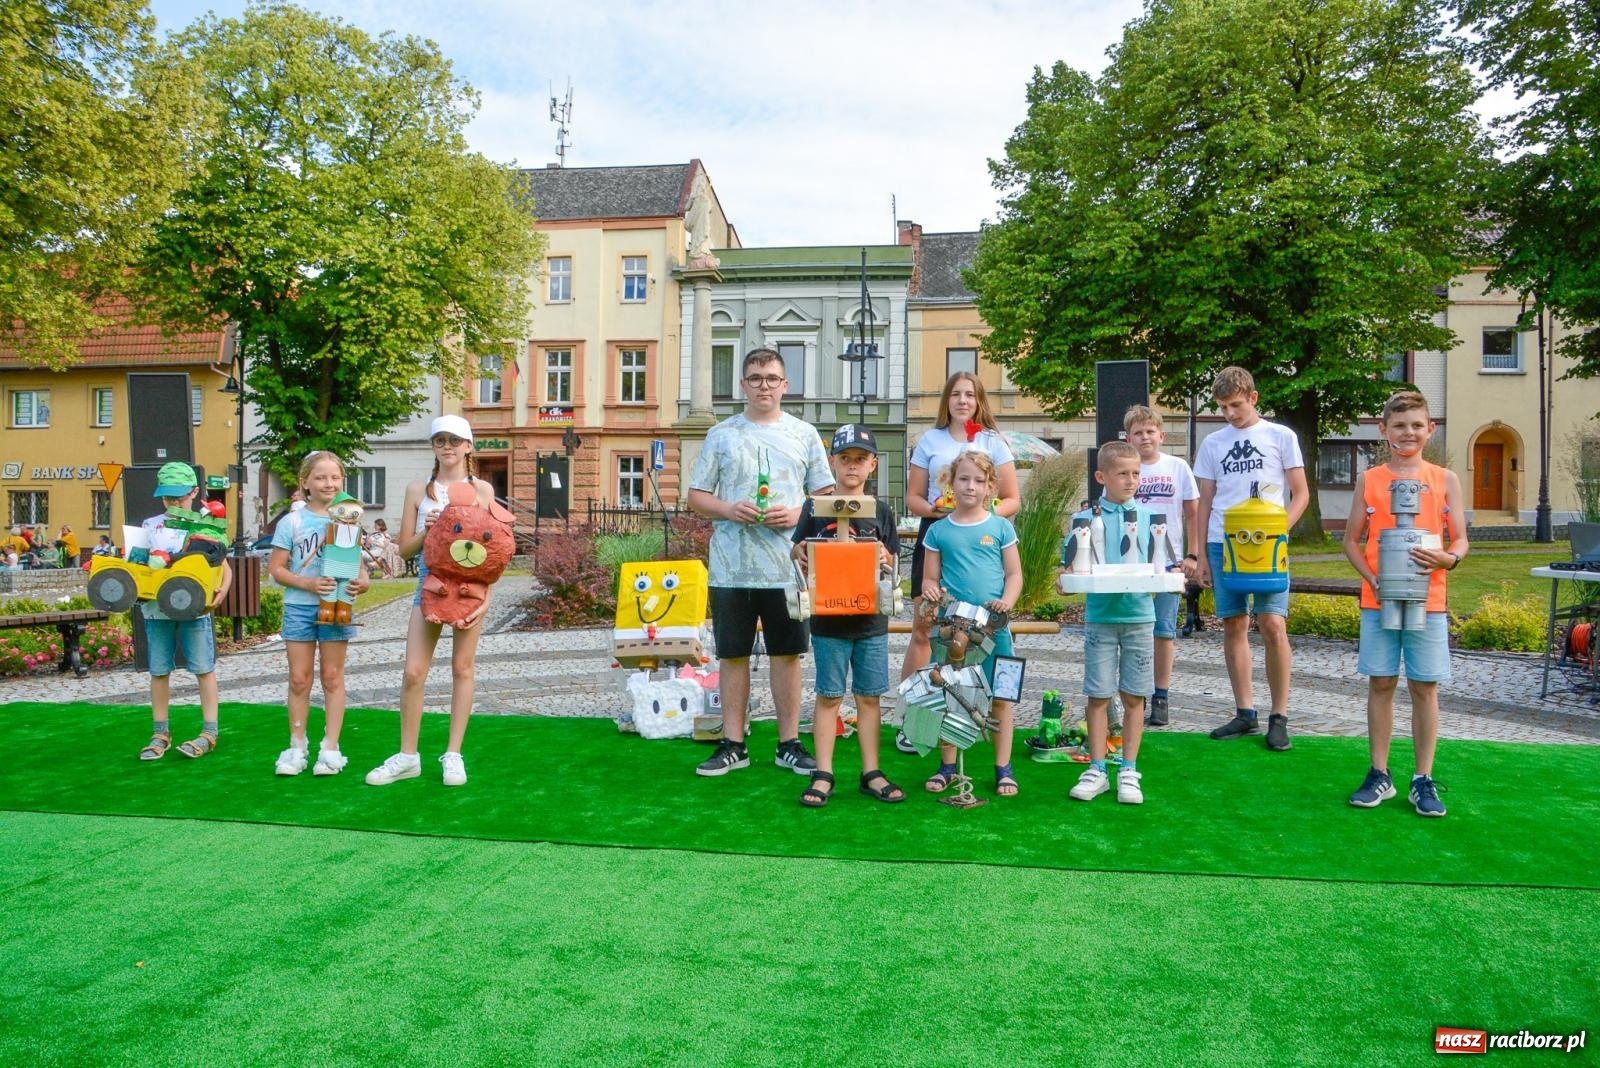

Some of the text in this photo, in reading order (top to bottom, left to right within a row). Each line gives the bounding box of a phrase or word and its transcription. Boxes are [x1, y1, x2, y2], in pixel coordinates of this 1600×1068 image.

[474, 439, 509, 452] pteka
[1222, 458, 1263, 475] Kappa
[31, 467, 75, 480] BANK
[1141, 476, 1173, 484] SUPER
